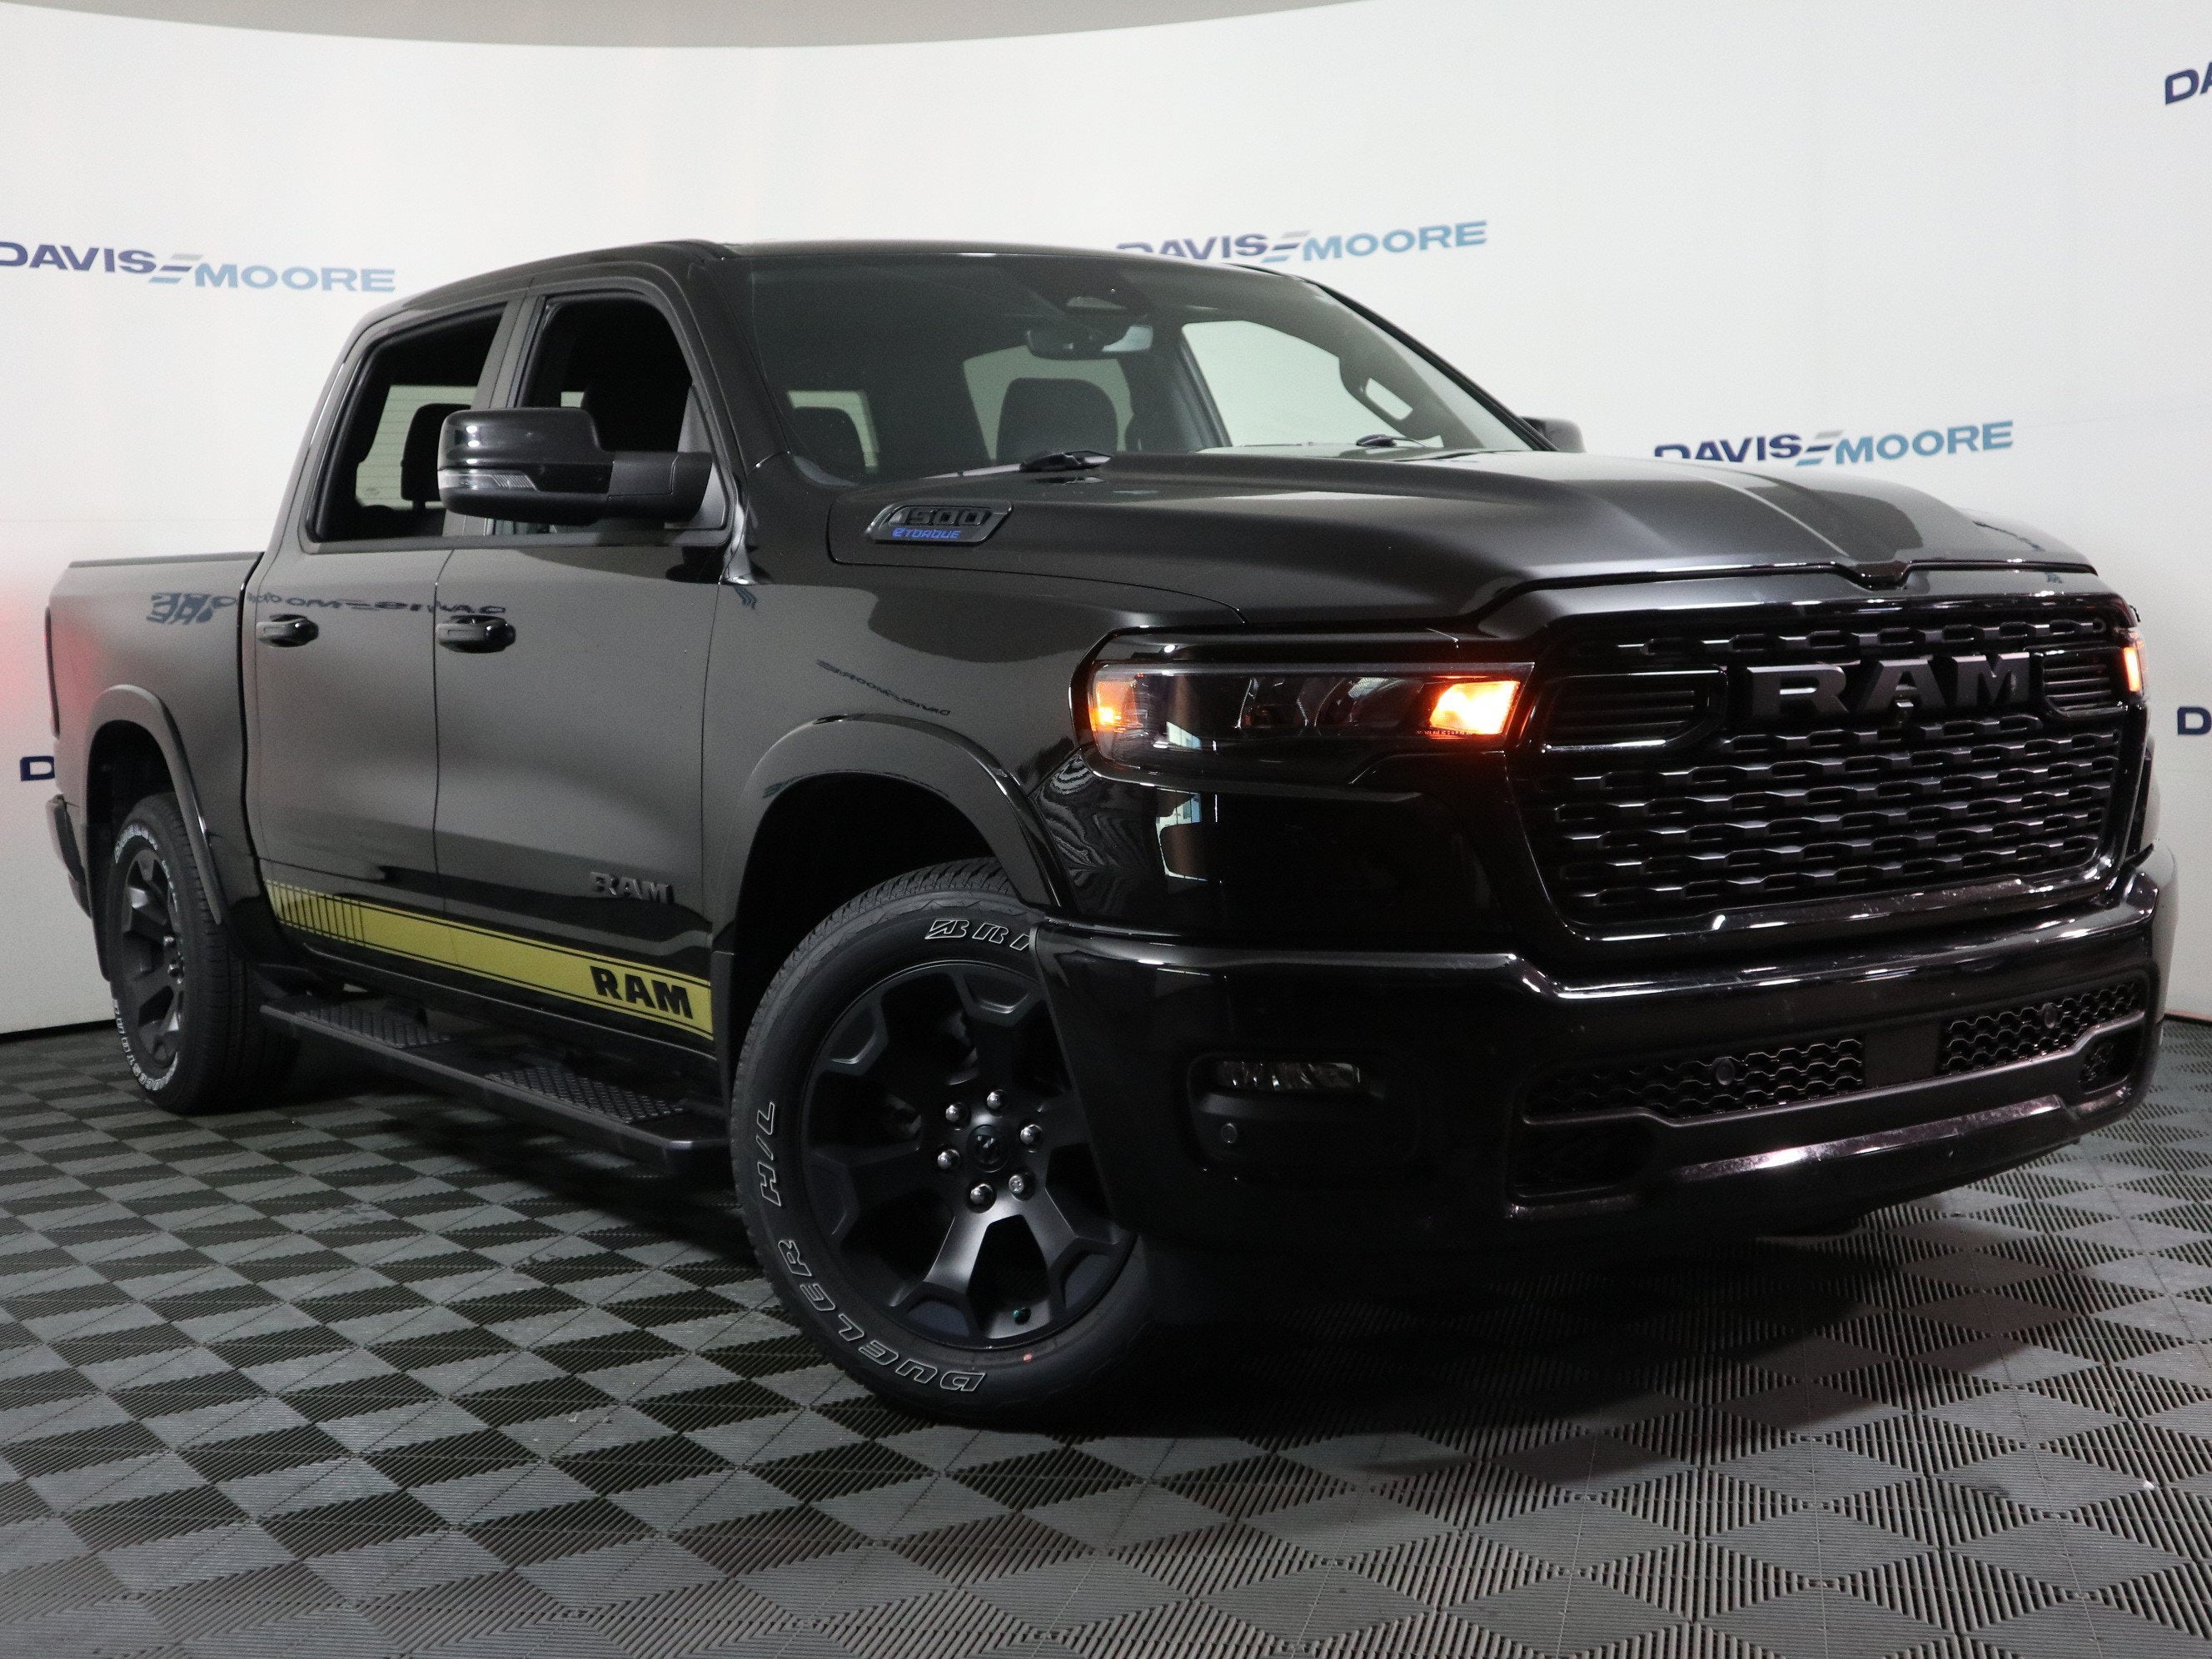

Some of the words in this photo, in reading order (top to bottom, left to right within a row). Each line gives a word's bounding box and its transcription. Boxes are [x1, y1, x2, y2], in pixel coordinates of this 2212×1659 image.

[0, 242, 157, 274] DAVIS
[194, 262, 396, 292] MOORE
[1302, 220, 1487, 262] MOORE
[1836, 420, 2014, 465] MOORE
[1746, 652, 2030, 717] RAM
[590, 871, 675, 904] RAM
[590, 965, 694, 1019] RAM
[755, 1101, 782, 1207] H/L
[778, 1238, 986, 1392] DUELER
